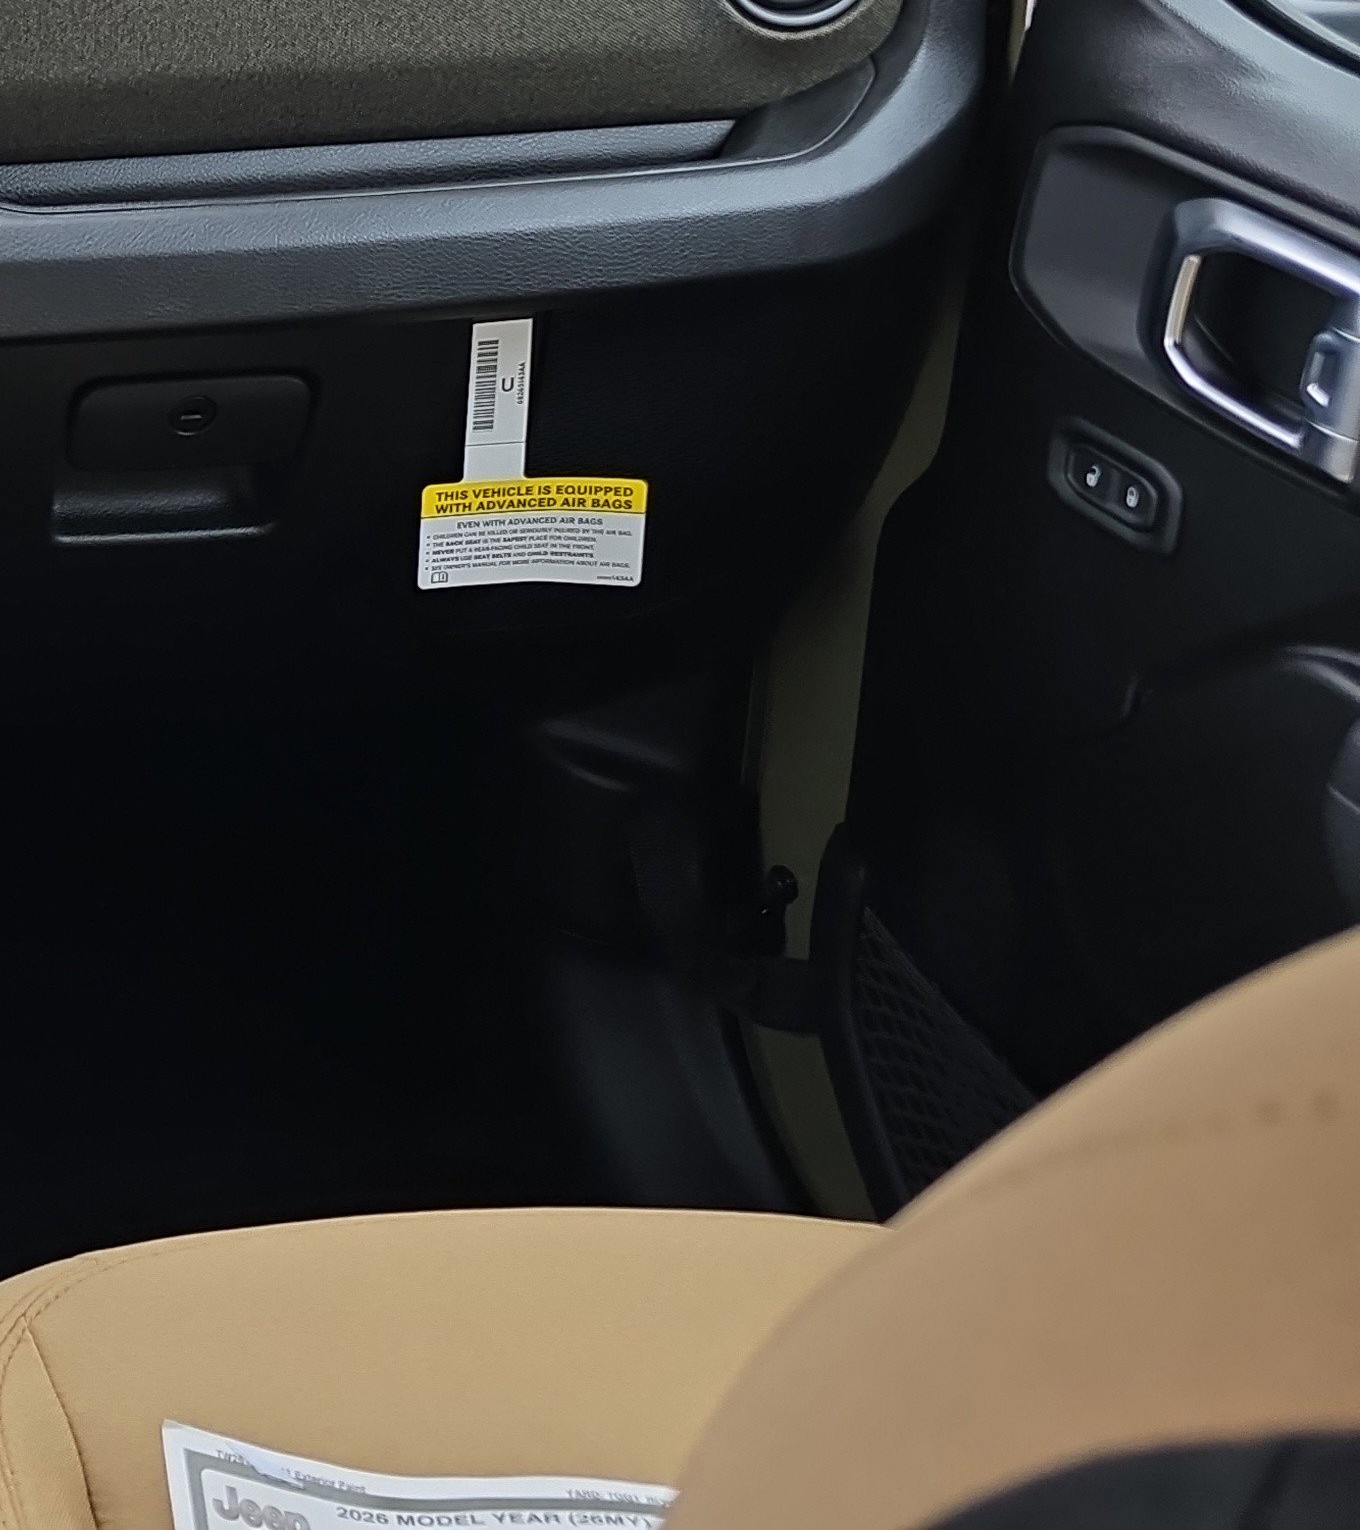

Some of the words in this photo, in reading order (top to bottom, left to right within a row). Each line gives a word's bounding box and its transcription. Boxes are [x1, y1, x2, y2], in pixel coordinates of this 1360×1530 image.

[436, 490, 469, 502] THIS
[472, 485, 533, 499] VEHICLE
[537, 485, 552, 496] IS
[555, 484, 634, 497] EQUIPPED
[435, 502, 472, 514] WITH
[475, 498, 557, 511] ADVANCED
[560, 498, 587, 508] AIR
[591, 498, 633, 510] BAGS
[457, 521, 480, 529] EVEN
[482, 519, 506, 527] WITH
[507, 517, 557, 525] ADVANCED
[559, 517, 576, 525] AIR
[578, 517, 603, 526] BAGS
[336, 1506, 389, 1525] 2026
[395, 1513, 486, 1527] MODEL
[491, 1512, 561, 1526] YEAR
